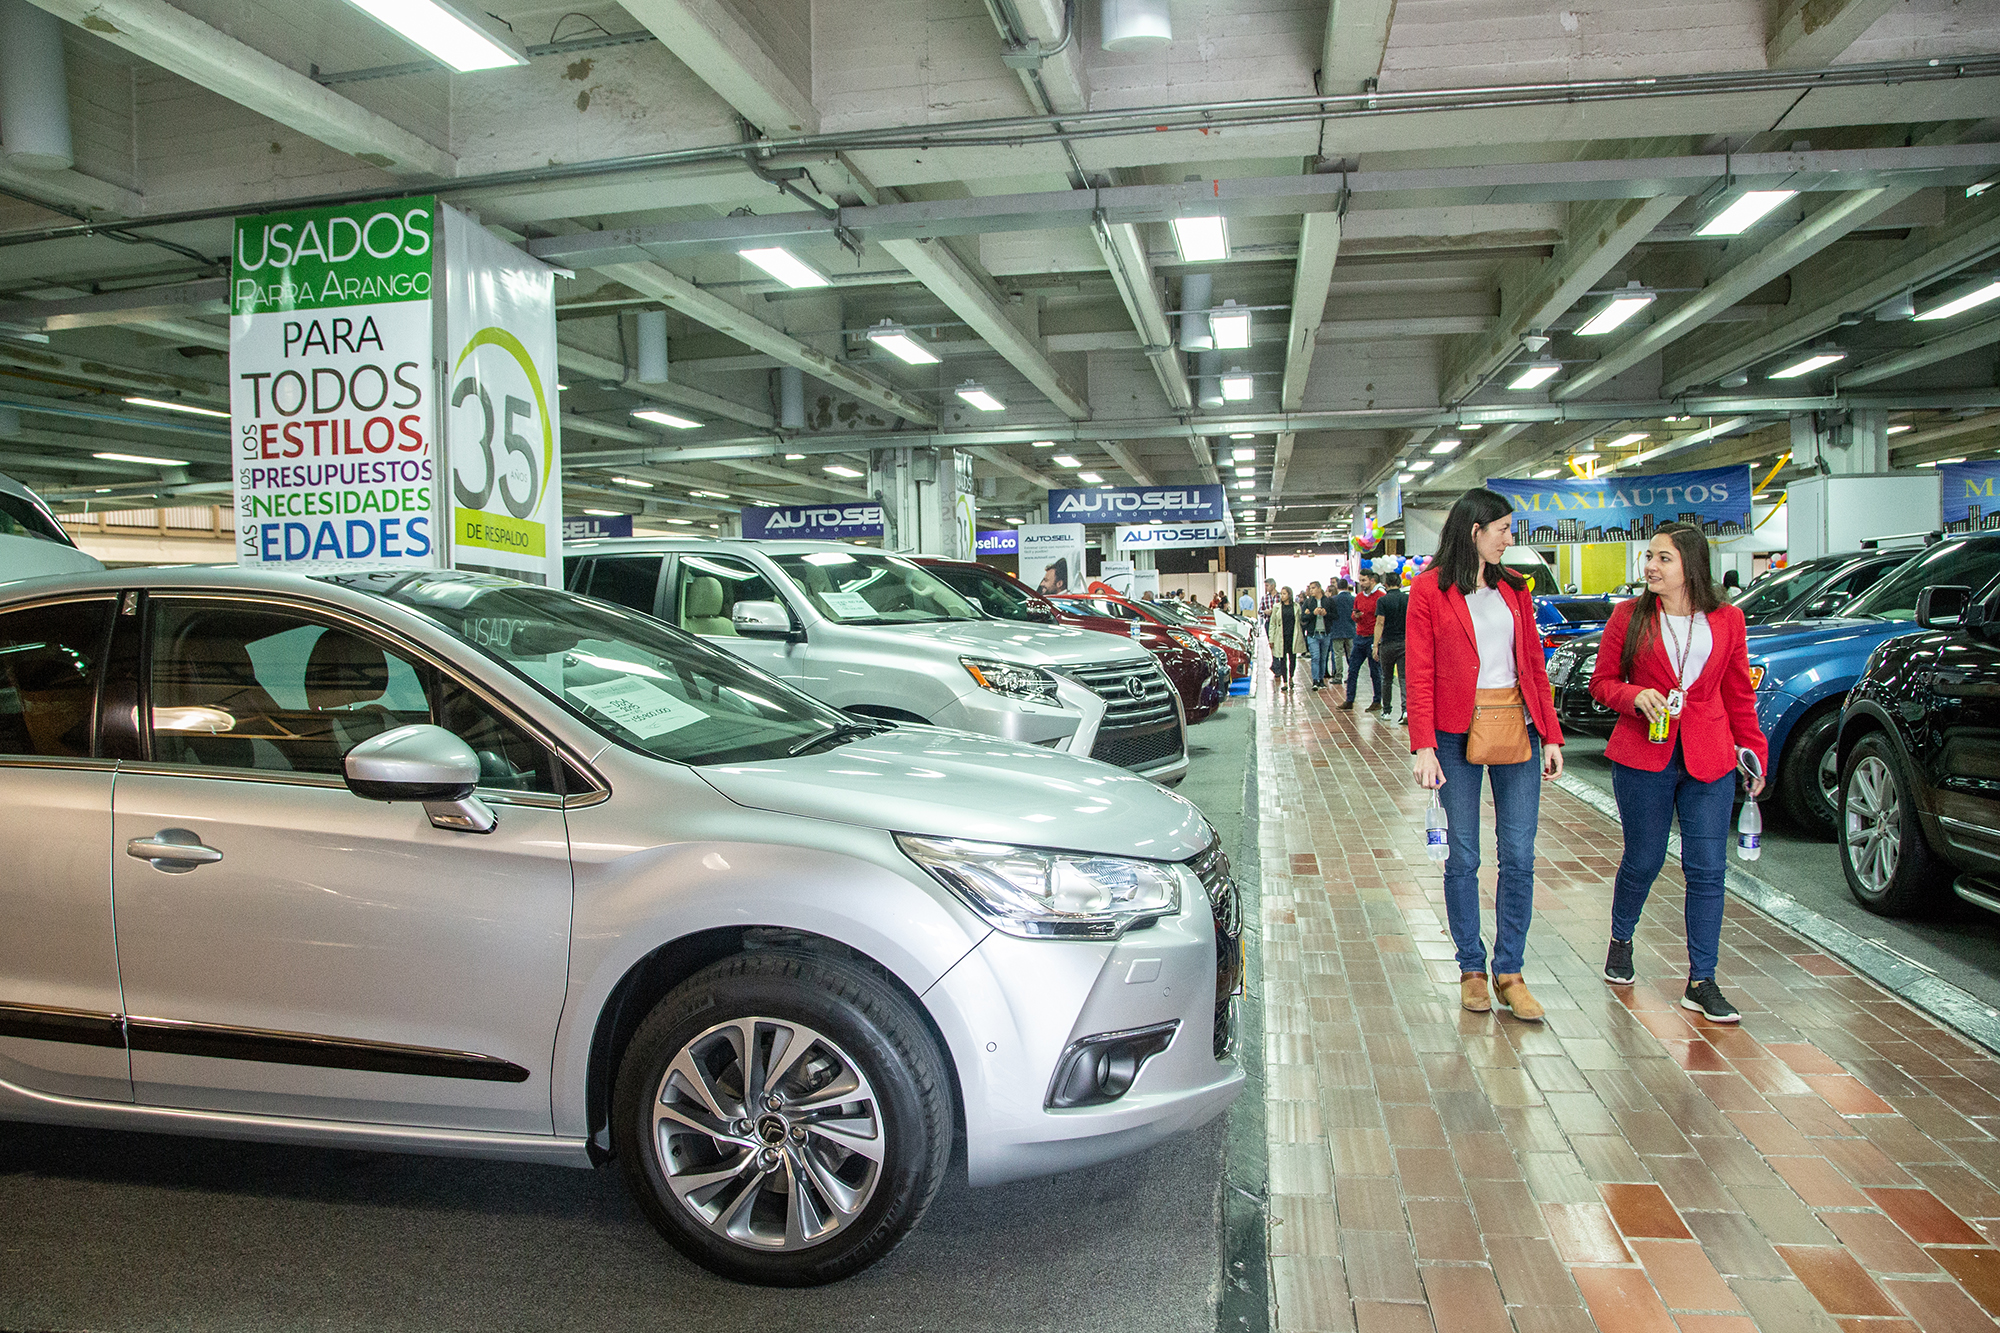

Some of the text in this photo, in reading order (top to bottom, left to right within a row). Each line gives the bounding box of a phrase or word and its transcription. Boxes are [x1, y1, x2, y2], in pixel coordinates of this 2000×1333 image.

[239, 209, 430, 271] USADOS
[320, 271, 432, 302] ARANGO
[284, 315, 383, 358] PARA
[241, 362, 422, 418] TODOS
[242, 425, 258, 460] LOS
[260, 415, 428, 460] ESTILOS,
[451, 376, 538, 519] 35
[240, 468, 250, 490] LOS
[252, 459, 432, 489] PRESUPUESTOS
[510, 468, 528, 483] AÑOS
[242, 495, 252, 518] LAS
[1057, 490, 1212, 512] AUTOSELL
[1513, 483, 1728, 512] MAXIAUTOS
[1057, 510, 1214, 518] AUTOMOTORES
[244, 525, 258, 557] LAS
[466, 522, 528, 548] DE RESPALDO
[1024, 534, 1074, 542] AUTOSELL
[1123, 528, 1226, 542] AUTOSELL
[464, 617, 531, 646] USADO
